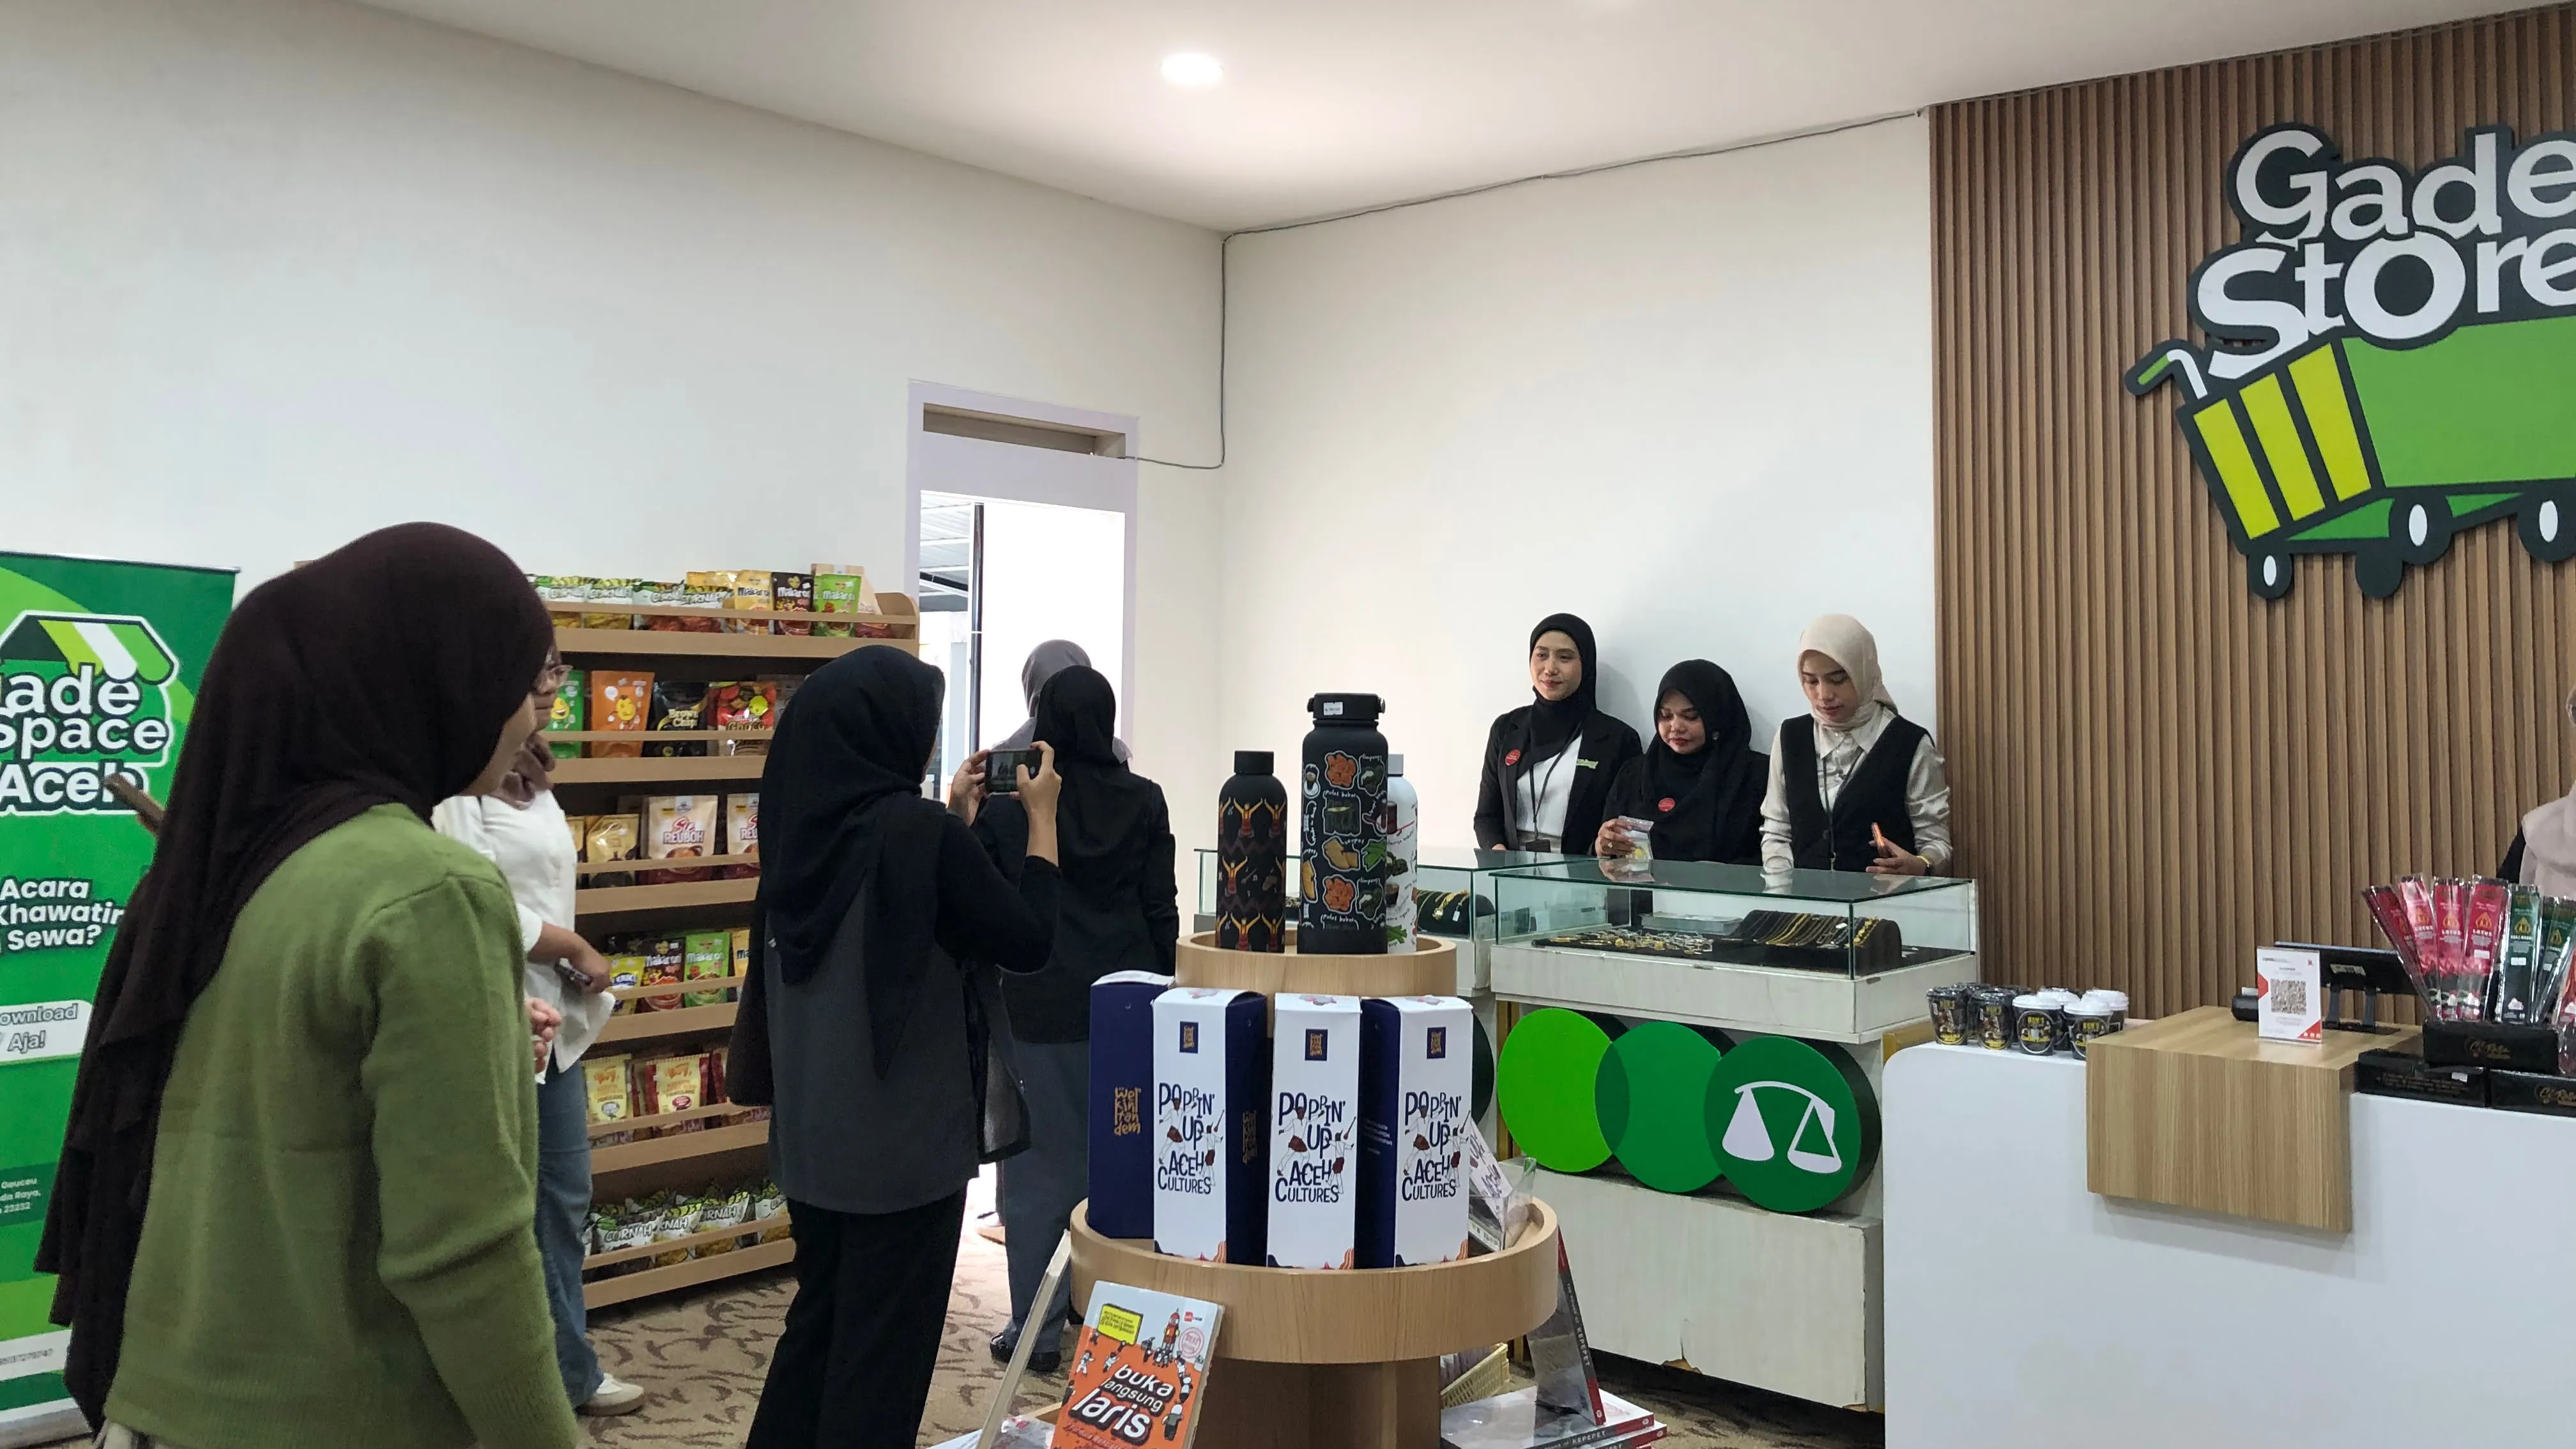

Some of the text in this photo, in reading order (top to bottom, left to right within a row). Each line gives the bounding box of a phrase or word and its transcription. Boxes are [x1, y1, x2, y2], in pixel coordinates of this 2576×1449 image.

[2236, 129, 2576, 250] Gade
[0, 665, 140, 717] ade
[741, 827, 758, 840] REU
[0, 878, 89, 900] Acara
[7, 924, 102, 951] Sewa?
[2472, 928, 2492, 937] LOTUS
[7, 1029, 46, 1054] Aja!
[1183, 1116, 1204, 1151] UP
[1307, 1124, 1332, 1159] UP
[1429, 1121, 1451, 1155] UP
[1169, 1150, 1204, 1176] ACEH
[1289, 1159, 1332, 1186] ACEH
[1414, 1154, 1451, 1184] ACEH
[1158, 1166, 1211, 1195] CULTURES
[1275, 1177, 1339, 1203] CULTURES
[1402, 1176, 1457, 1202] CULTURES
[1577, 1326, 1591, 1366] KEPEPET
[1101, 1377, 1163, 1413] langsung
[1114, 1364, 1174, 1397] buka
[1071, 1388, 1151, 1438] laris
[1572, 1430, 1606, 1444] KEPEPET
